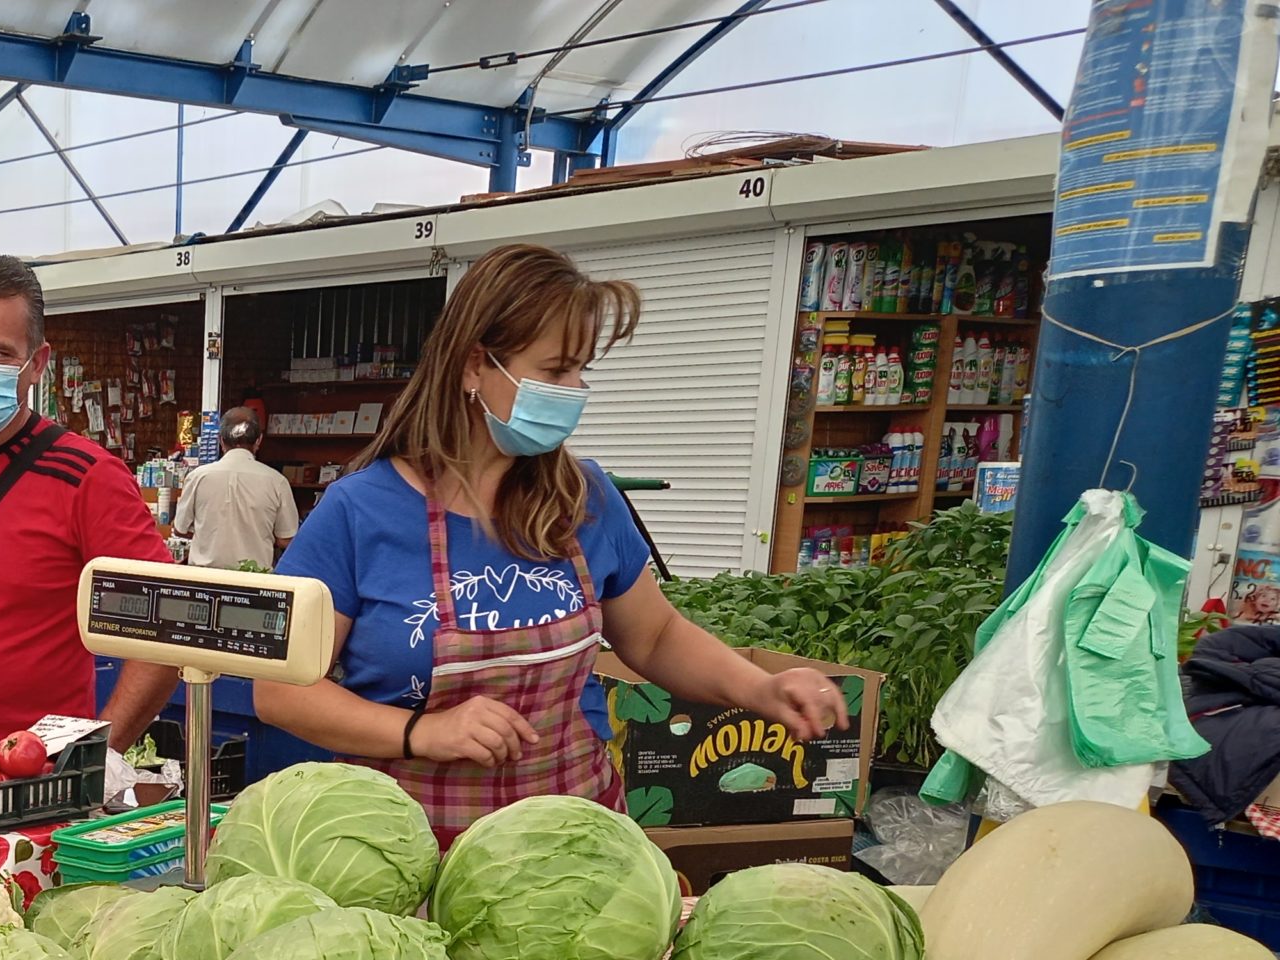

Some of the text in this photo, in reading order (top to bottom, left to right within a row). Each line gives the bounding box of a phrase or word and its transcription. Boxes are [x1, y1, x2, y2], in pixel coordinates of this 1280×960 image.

[738, 176, 765, 199] 40
[413, 220, 434, 240] 39
[175, 250, 192, 267] 38
[233, 597, 250, 605] TOTAL
[259, 590, 287, 599] PANTHER
[90, 620, 157, 637] PARTNER CORPORATION
